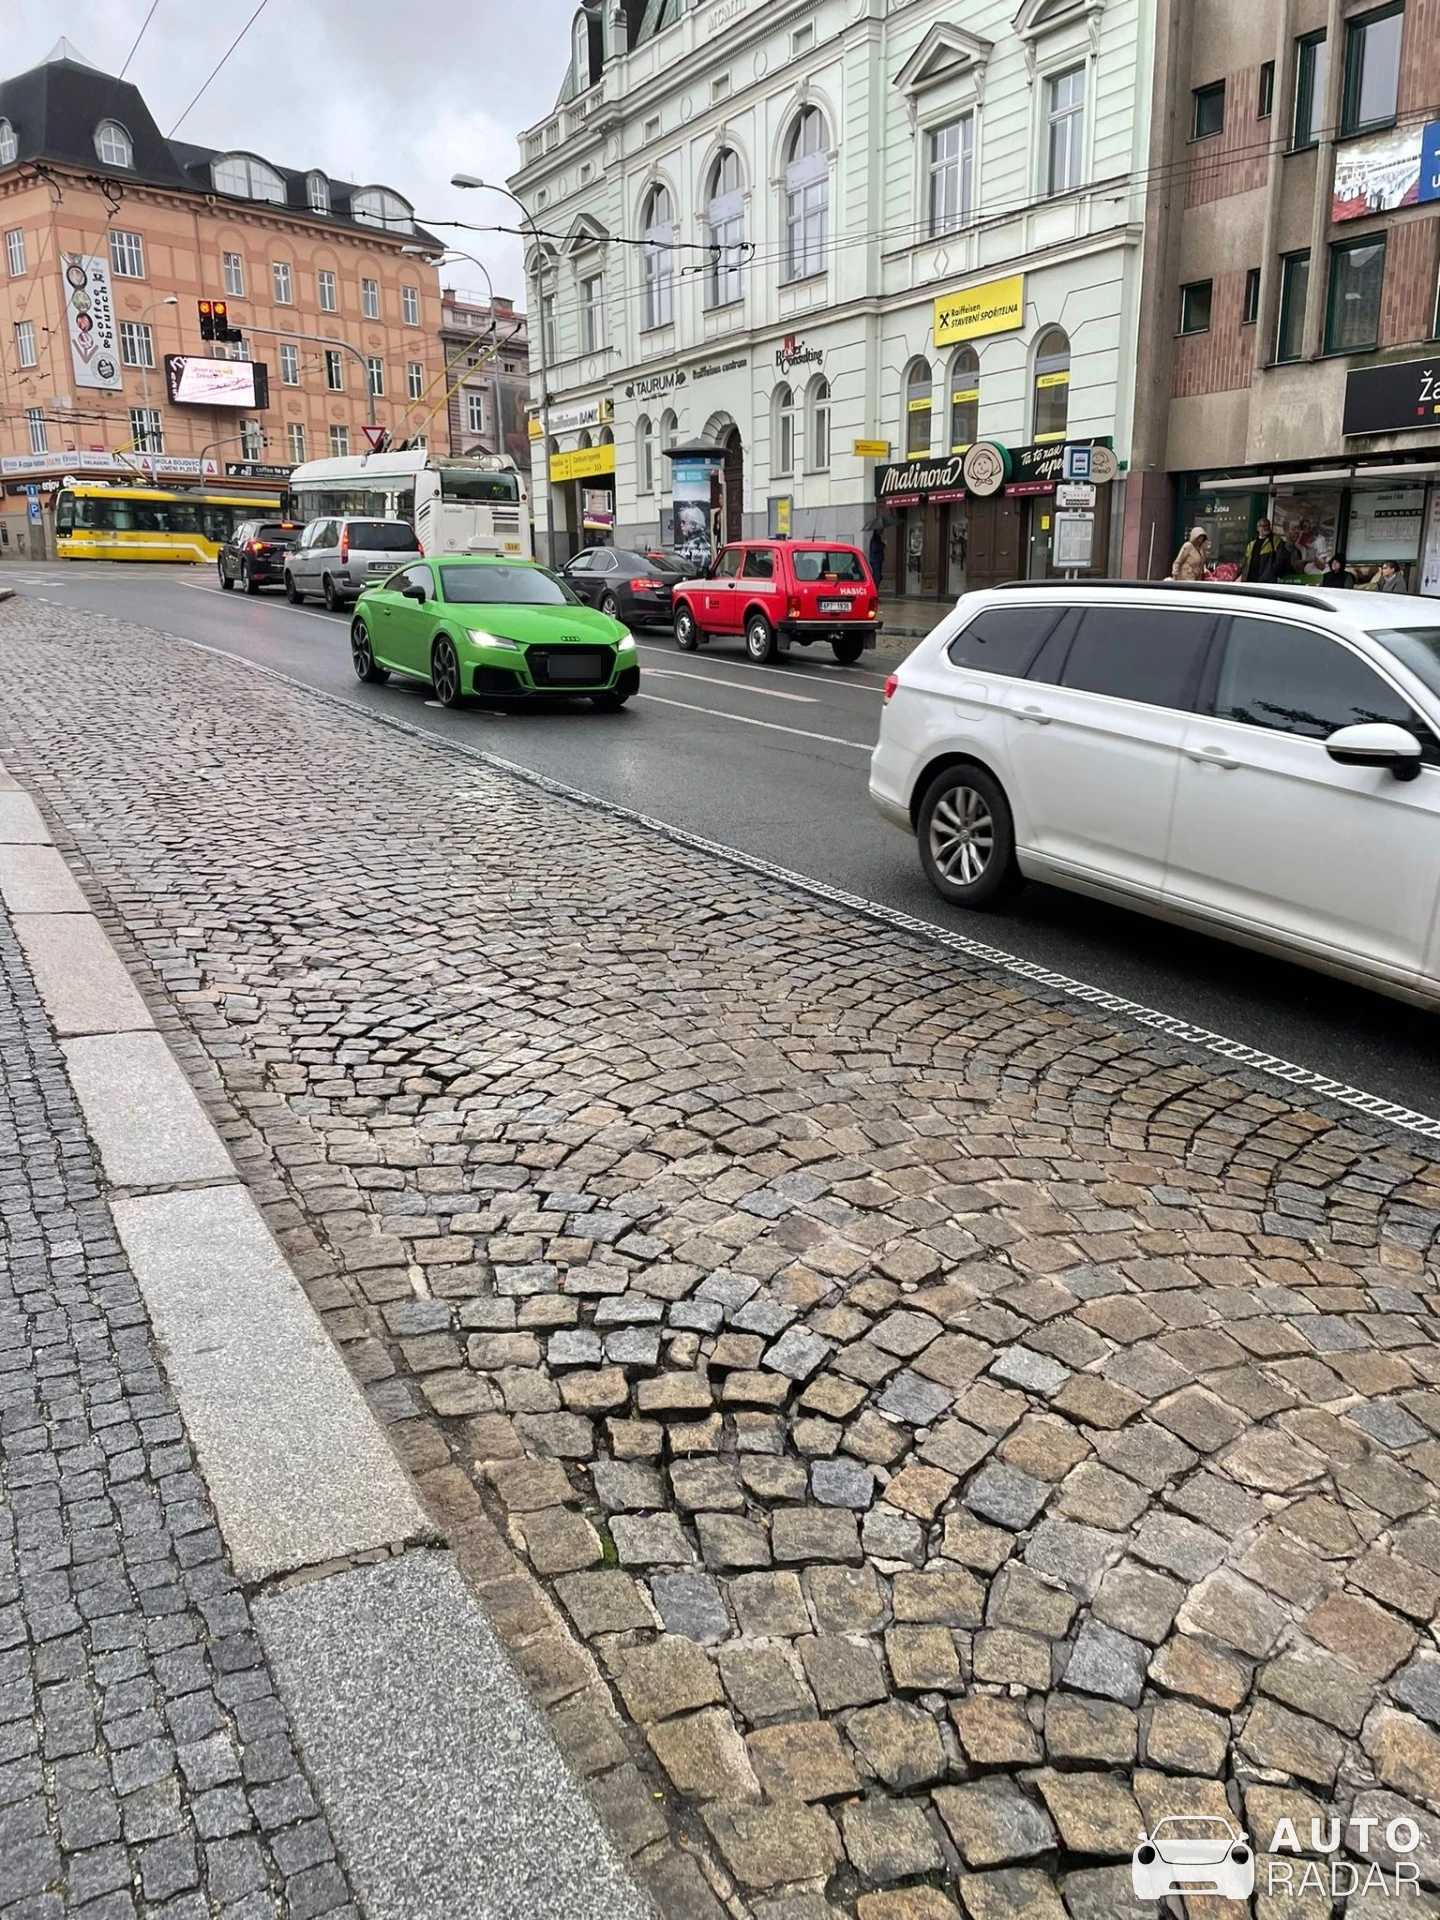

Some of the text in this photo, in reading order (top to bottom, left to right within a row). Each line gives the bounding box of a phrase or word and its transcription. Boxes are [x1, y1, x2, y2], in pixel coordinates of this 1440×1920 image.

[94, 289, 105, 338] coffee
[951, 304, 980, 317] Raiffeisen
[951, 304, 1018, 328] STAVEBNÍ SPOŘITELNA
[722, 358, 748, 373] centrum
[781, 347, 823, 375] Consulting
[636, 373, 674, 395] TAURUM
[579, 408, 599, 426] BANK
[880, 456, 963, 495] Malinová
[839, 587, 867, 596] HASIČI
